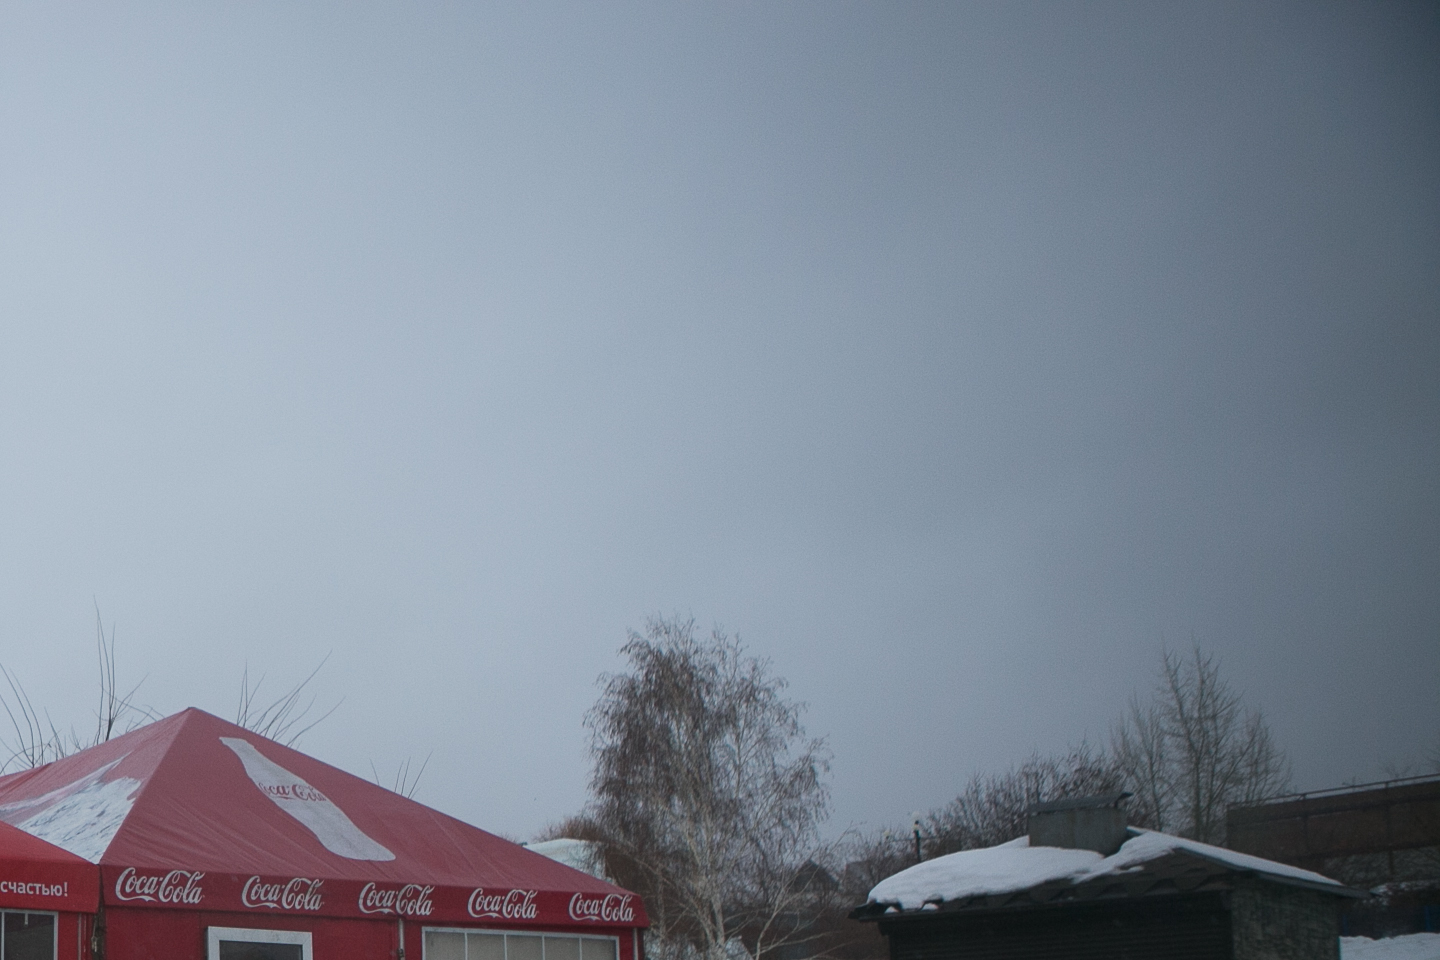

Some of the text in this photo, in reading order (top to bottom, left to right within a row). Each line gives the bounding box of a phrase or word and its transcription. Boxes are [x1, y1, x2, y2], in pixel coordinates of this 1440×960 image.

[0, 881, 68, 896] счастью!
[115, 867, 205, 903] Coca-Cola
[242, 876, 323, 910] Coca-Cola
[359, 882, 433, 915] Coca-Cola
[468, 888, 537, 918] Coca-Cola
[569, 892, 635, 921] Coca-Cola
